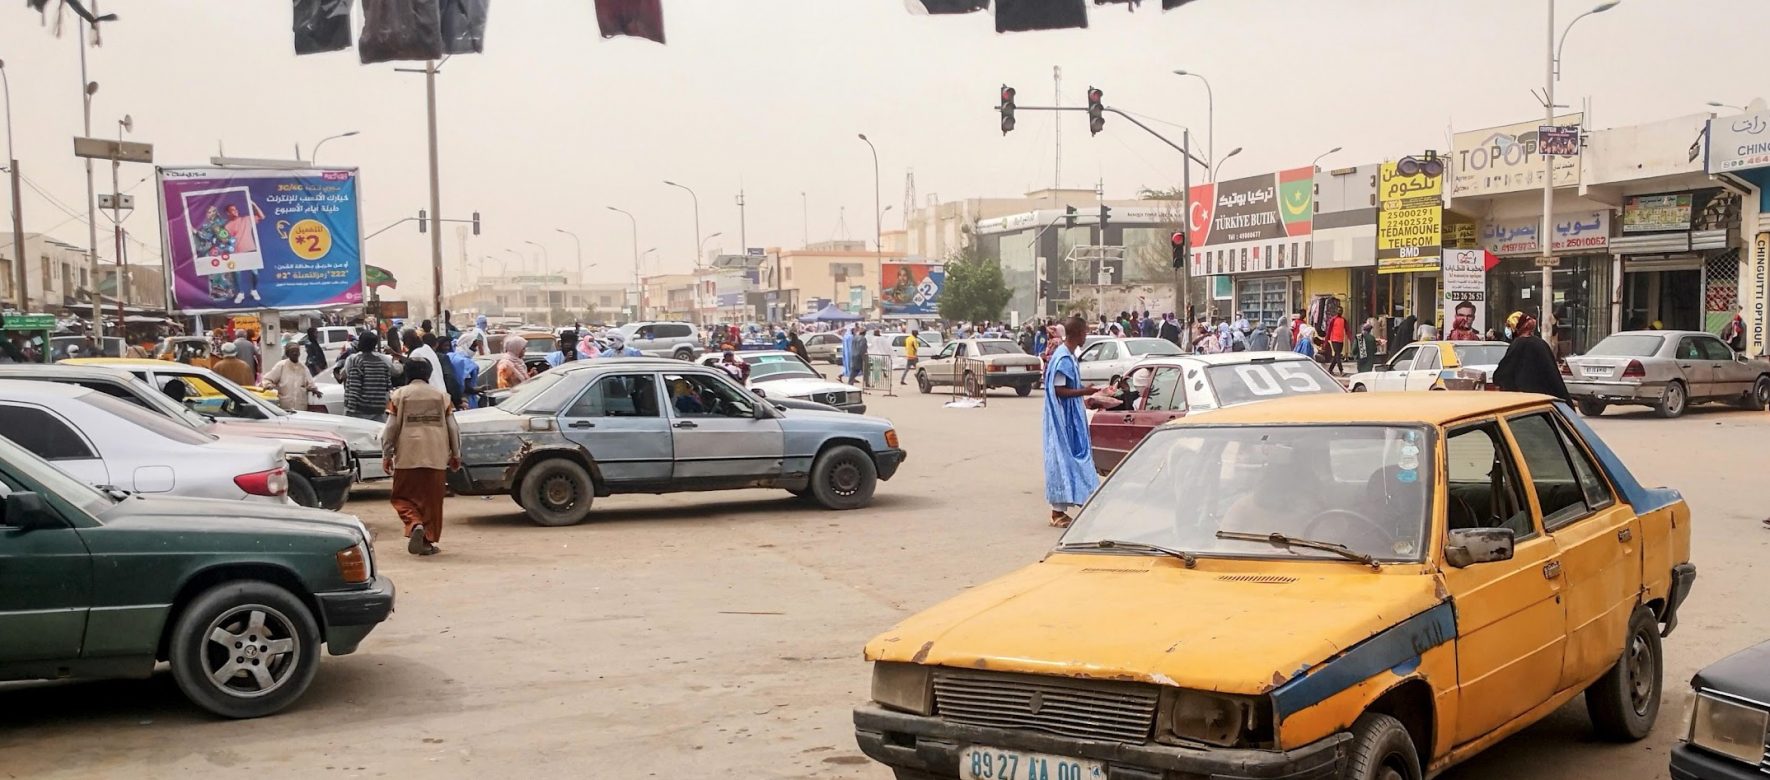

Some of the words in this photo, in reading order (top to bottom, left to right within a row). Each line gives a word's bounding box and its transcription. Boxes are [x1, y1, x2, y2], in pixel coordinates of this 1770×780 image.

[1460, 140, 1573, 173] TOPOP
[1219, 193, 1247, 208] بوتيك
[1247, 187, 1273, 205] تركيا
[1215, 212, 1250, 230] TÜRKİYE
[1250, 211, 1276, 226] BUTIK
[1387, 217, 1434, 228] 22402529
[1388, 209, 1433, 219] 25000291
[1389, 236, 1433, 248] TELECOM
[1400, 247, 1420, 258] BMD
[1755, 240, 1766, 299] CHINGUITTI
[1753, 303, 1764, 347] OPTIQUE
[1235, 362, 1321, 396] 05
[971, 751, 993, 779] 89
[998, 753, 1019, 780] 27
[1029, 757, 1049, 780] AA
